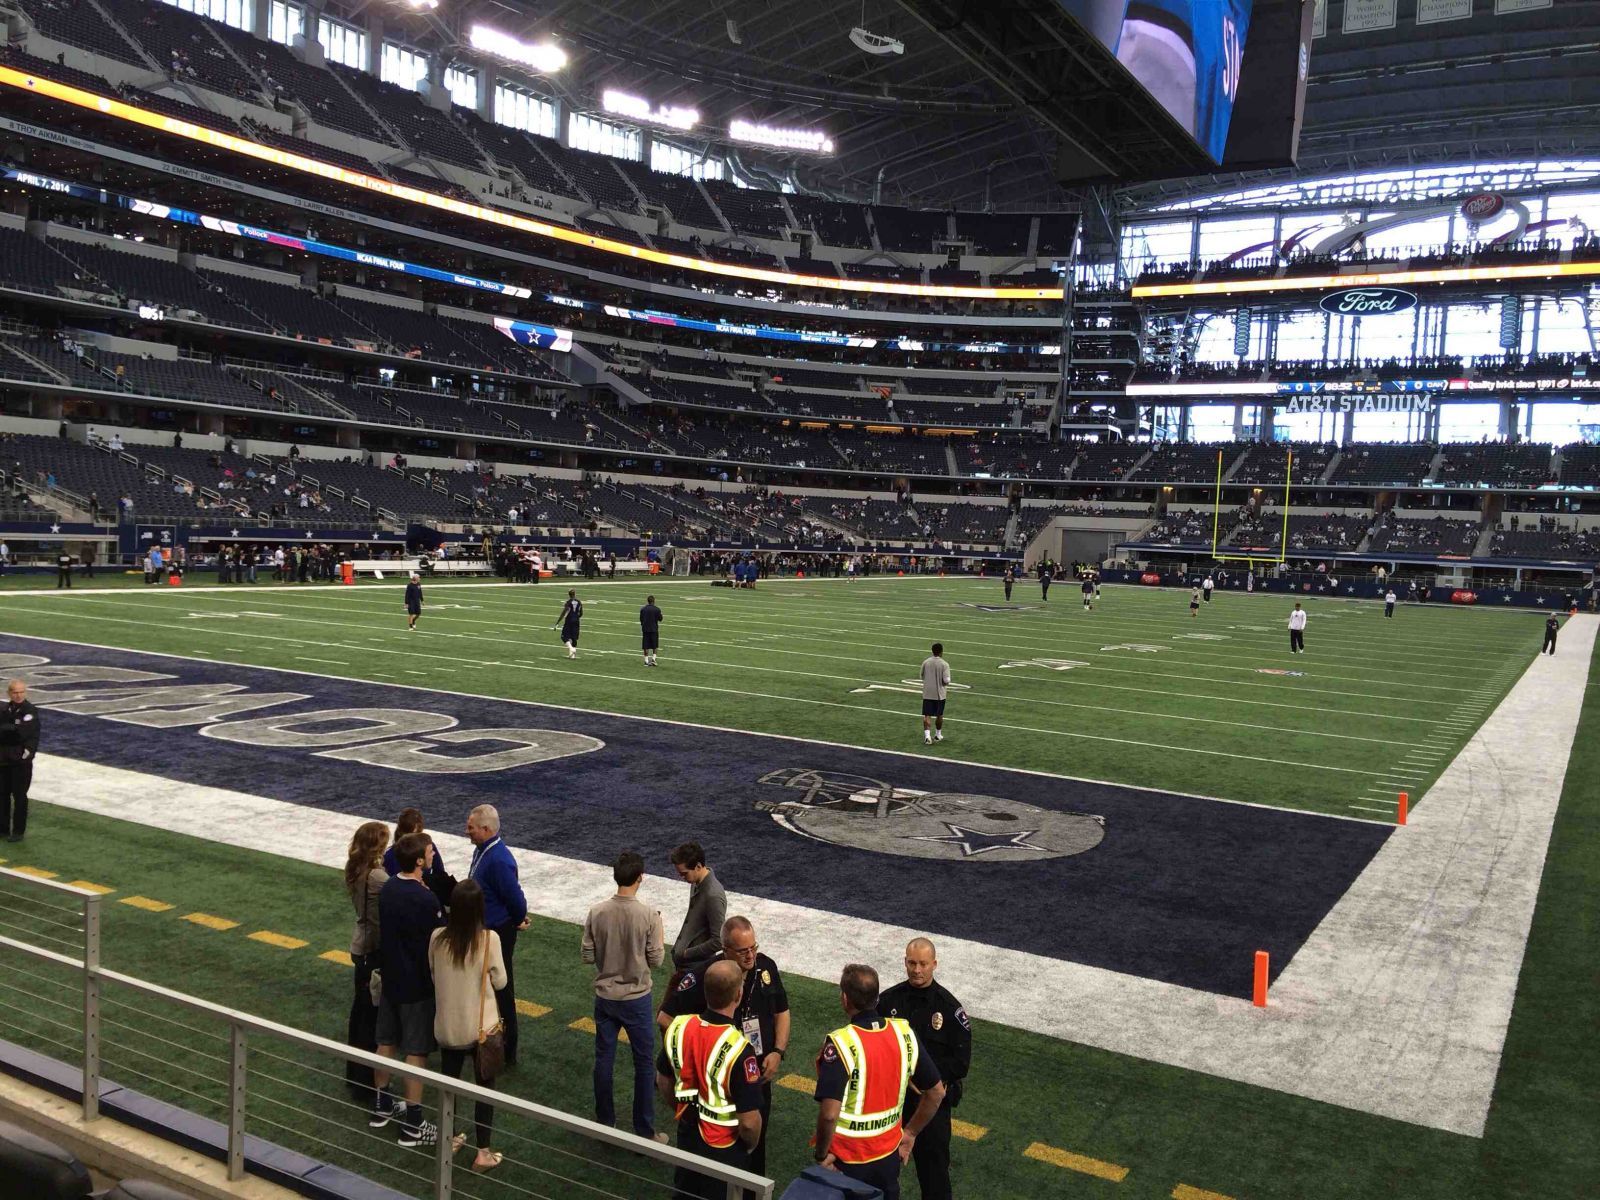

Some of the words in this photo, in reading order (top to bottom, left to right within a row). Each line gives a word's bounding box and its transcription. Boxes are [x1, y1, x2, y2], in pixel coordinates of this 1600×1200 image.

[1347, 11, 1393, 21] CHAMPIONS
[17, 123, 37, 135] TROY
[38, 129, 68, 144] AIKMAN
[17, 172, 40, 187] APRIL
[50, 181, 70, 193] 2014
[172, 168, 199, 180] EMMITT
[200, 174, 221, 185] SMITH
[243, 227, 268, 239] Pollock
[357, 253, 373, 264] NCAA
[390, 260, 405, 271] FOUR
[1338, 291, 1398, 312] Ford
[1467, 380, 1496, 391] Quality
[1496, 380, 1515, 389] brick
[1515, 380, 1536, 389] since
[1537, 379, 1556, 389] 1891
[1286, 394, 1336, 413] AT&T
[1339, 394, 1431, 412] STADIUM
[671, 1023, 681, 1070] FIRE
[849, 1045, 860, 1091] FRE
[849, 1112, 900, 1132] ARLINGTON
